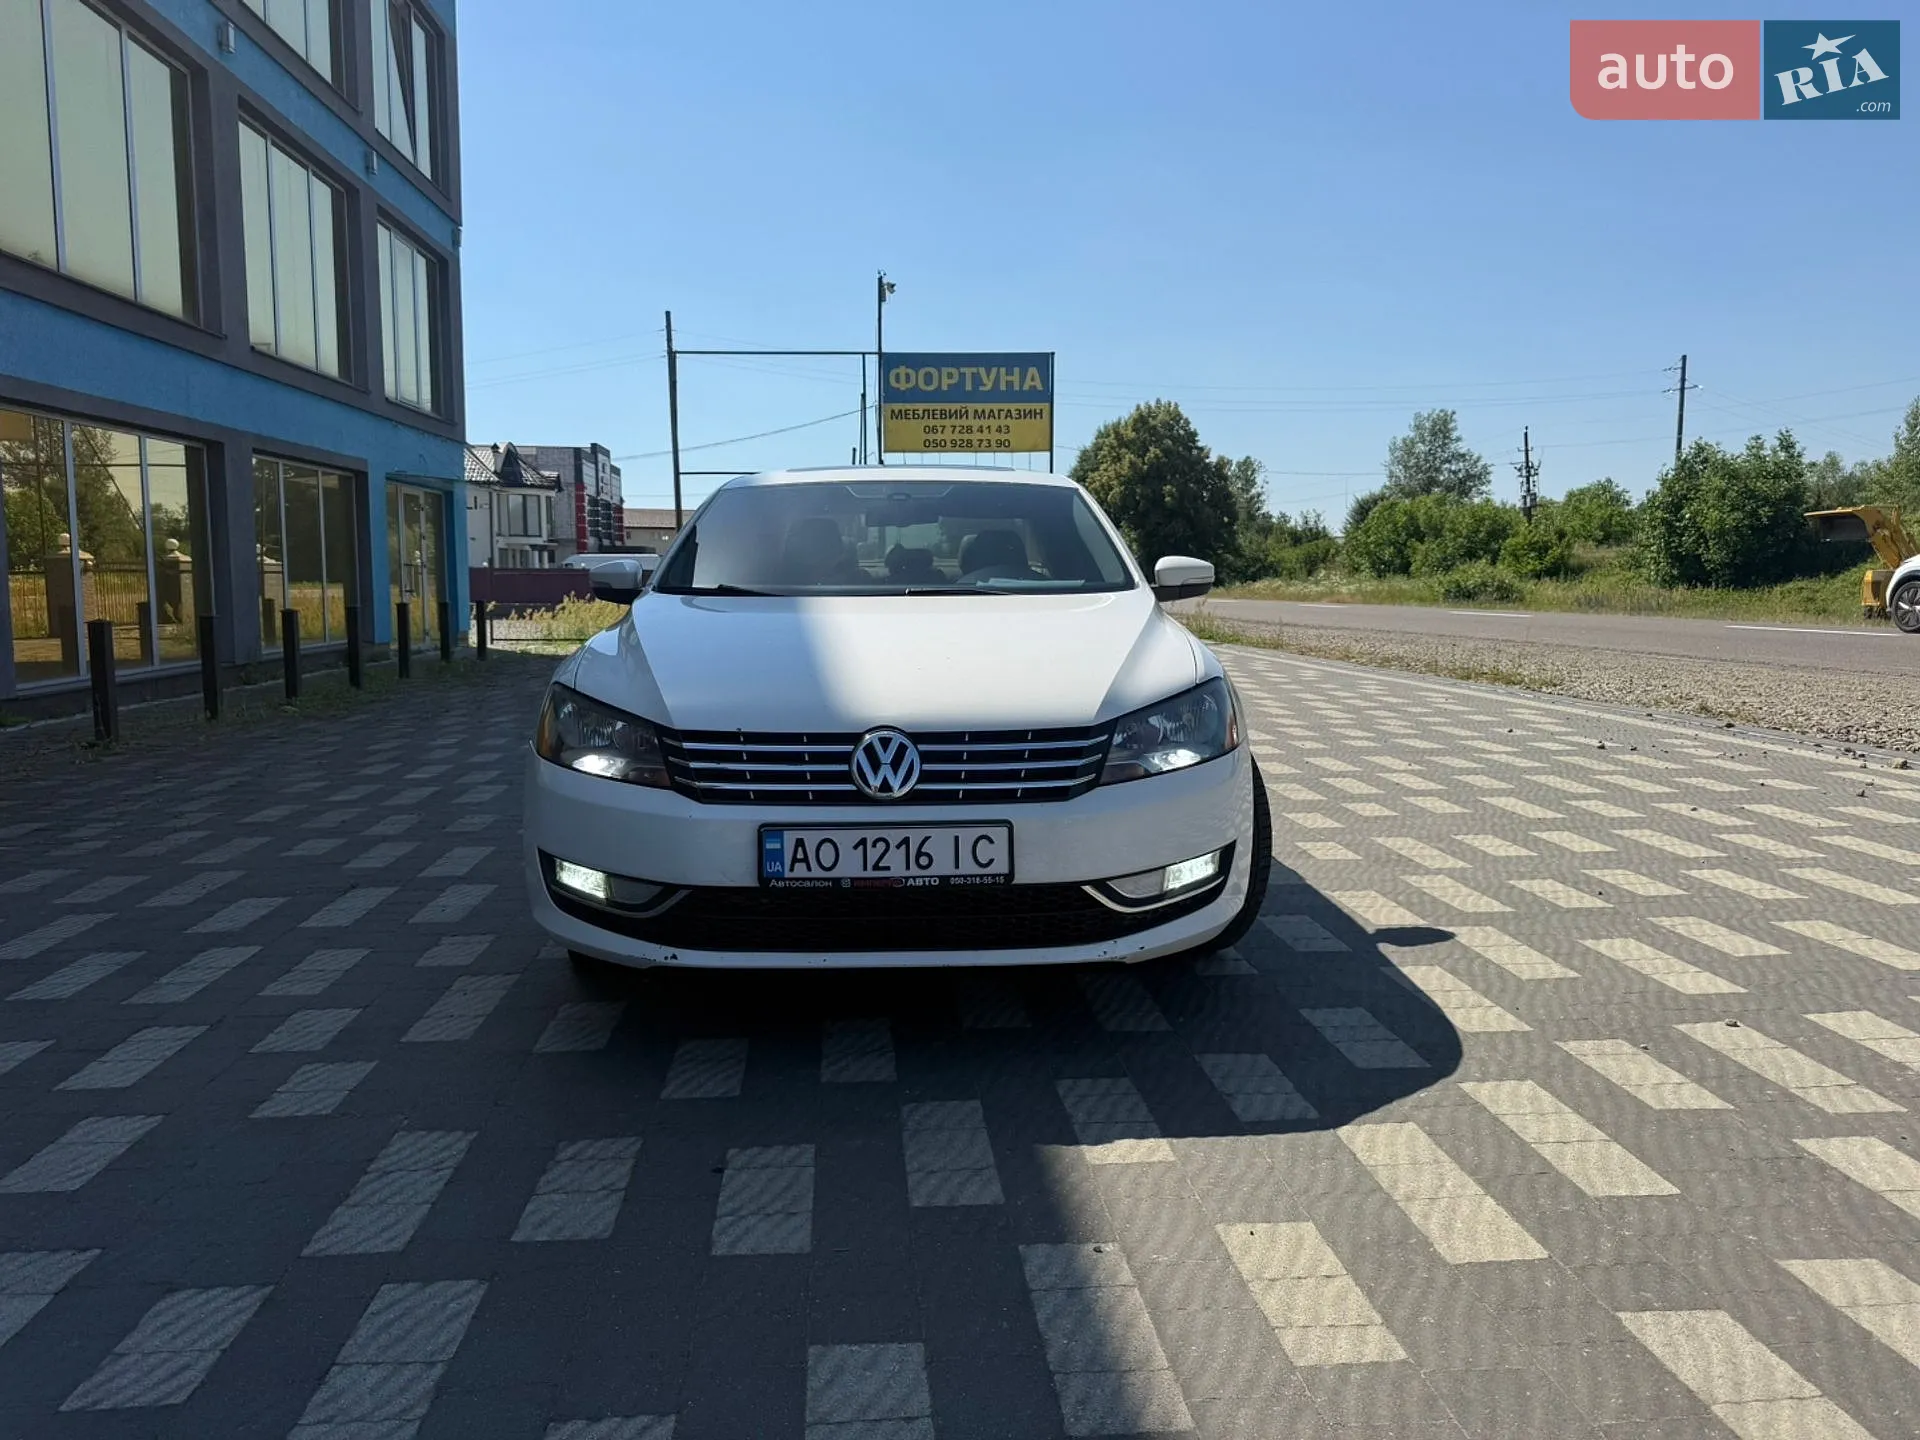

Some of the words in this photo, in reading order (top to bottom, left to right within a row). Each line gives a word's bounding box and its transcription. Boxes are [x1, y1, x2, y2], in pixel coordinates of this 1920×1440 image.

[889, 366, 1043, 391] ФОРТУНА
[890, 406, 969, 420] МЕБЛЕВИЙ
[973, 408, 1043, 420] МАГАЗИН
[923, 425, 946, 434] 067
[950, 425, 973, 434] 728
[976, 425, 991, 434] 41
[995, 425, 1010, 434] 43
[923, 439, 946, 448] 050
[950, 439, 973, 448] 928
[976, 439, 991, 448] 73
[995, 439, 1011, 448] 90
[856, 735, 916, 793] VW
[789, 837, 840, 872] AO
[852, 835, 934, 871] 1216
[953, 834, 996, 869] IC
[766, 861, 783, 873] UA
[769, 878, 833, 888] Автосалон
[907, 877, 940, 887] АВТО
